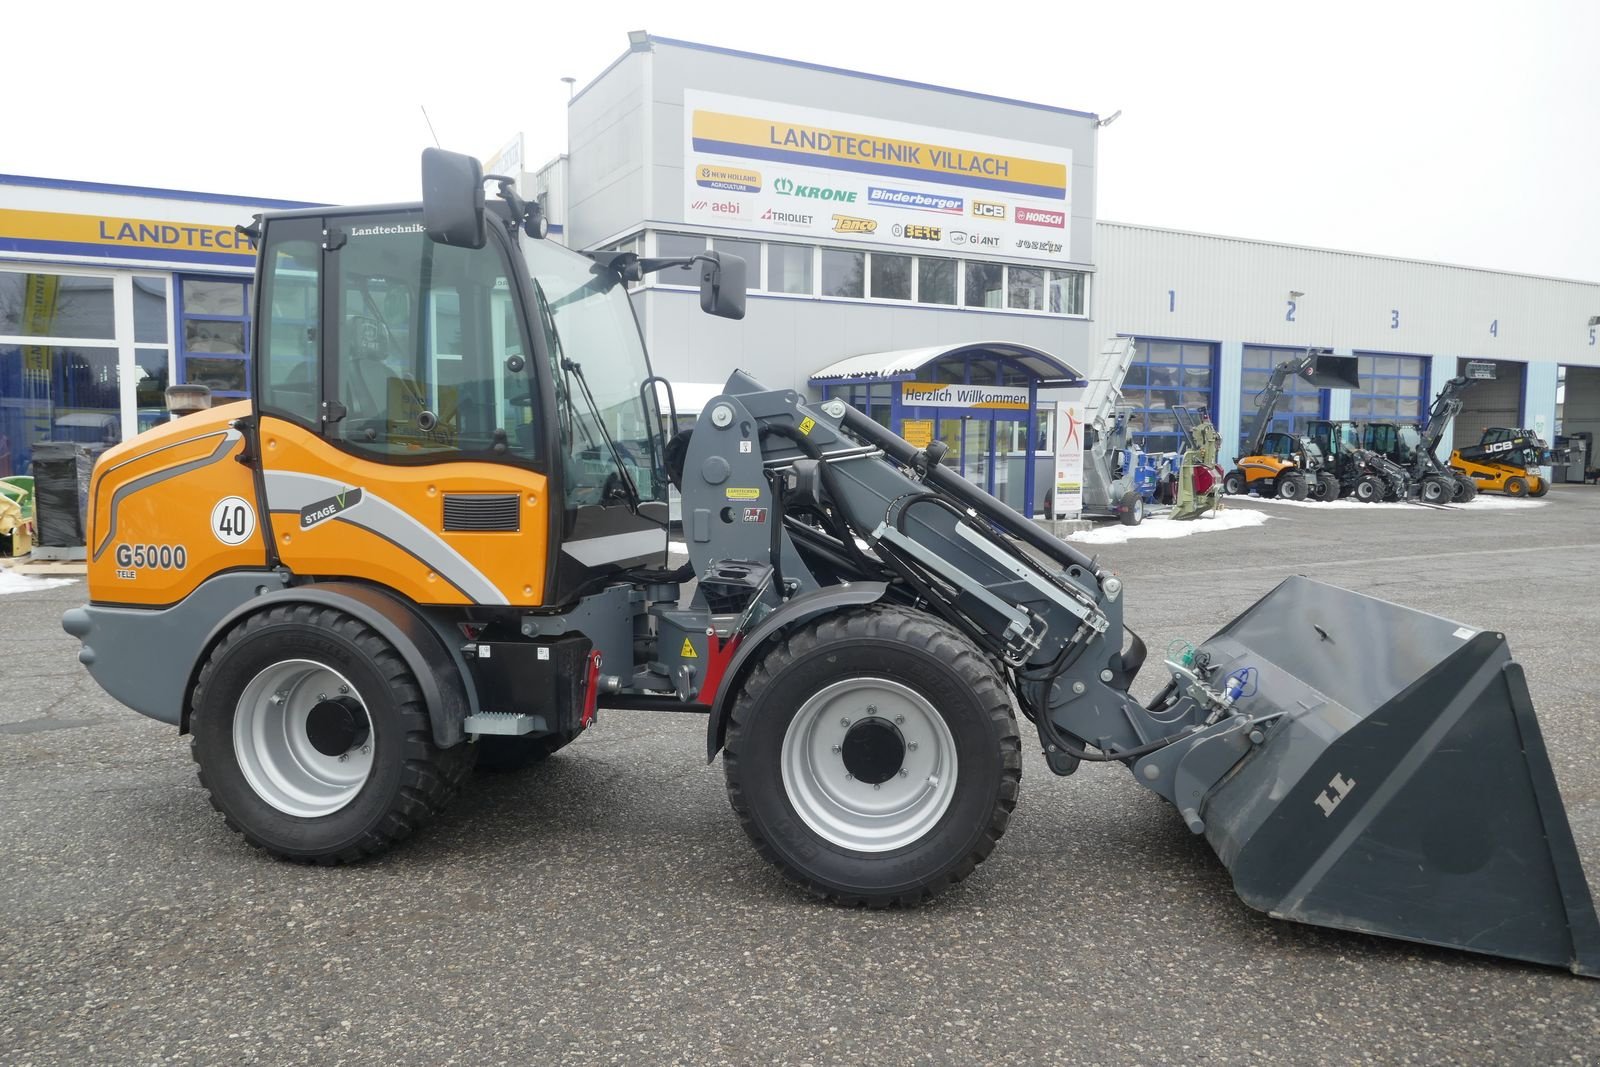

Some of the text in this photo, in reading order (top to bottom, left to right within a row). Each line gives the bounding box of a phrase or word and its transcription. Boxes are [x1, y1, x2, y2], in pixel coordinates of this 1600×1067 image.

[770, 125, 1009, 177] LANDTECHNIK VILLACH
[710, 182, 747, 191] AGRICULTURE
[727, 173, 757, 182] HOLLAND
[794, 184, 858, 203] KRONE
[871, 189, 961, 209] Binderberger
[711, 201, 740, 214] aebi
[974, 204, 1005, 217] JCB
[832, 214, 878, 233] Tanco
[1025, 214, 1062, 225] HORSCH
[1168, 290, 1175, 312] 1
[1286, 301, 1296, 322] 2
[1390, 309, 1399, 329] 3
[1489, 319, 1498, 338] 4
[1588, 328, 1596, 346] 5
[905, 388, 1027, 405] Herzlich Willkommen
[1484, 440, 1513, 454] JCB
[219, 505, 246, 536] 40
[305, 504, 337, 524] STAGE
[116, 544, 187, 569] G5000
[116, 570, 136, 579] TELE
